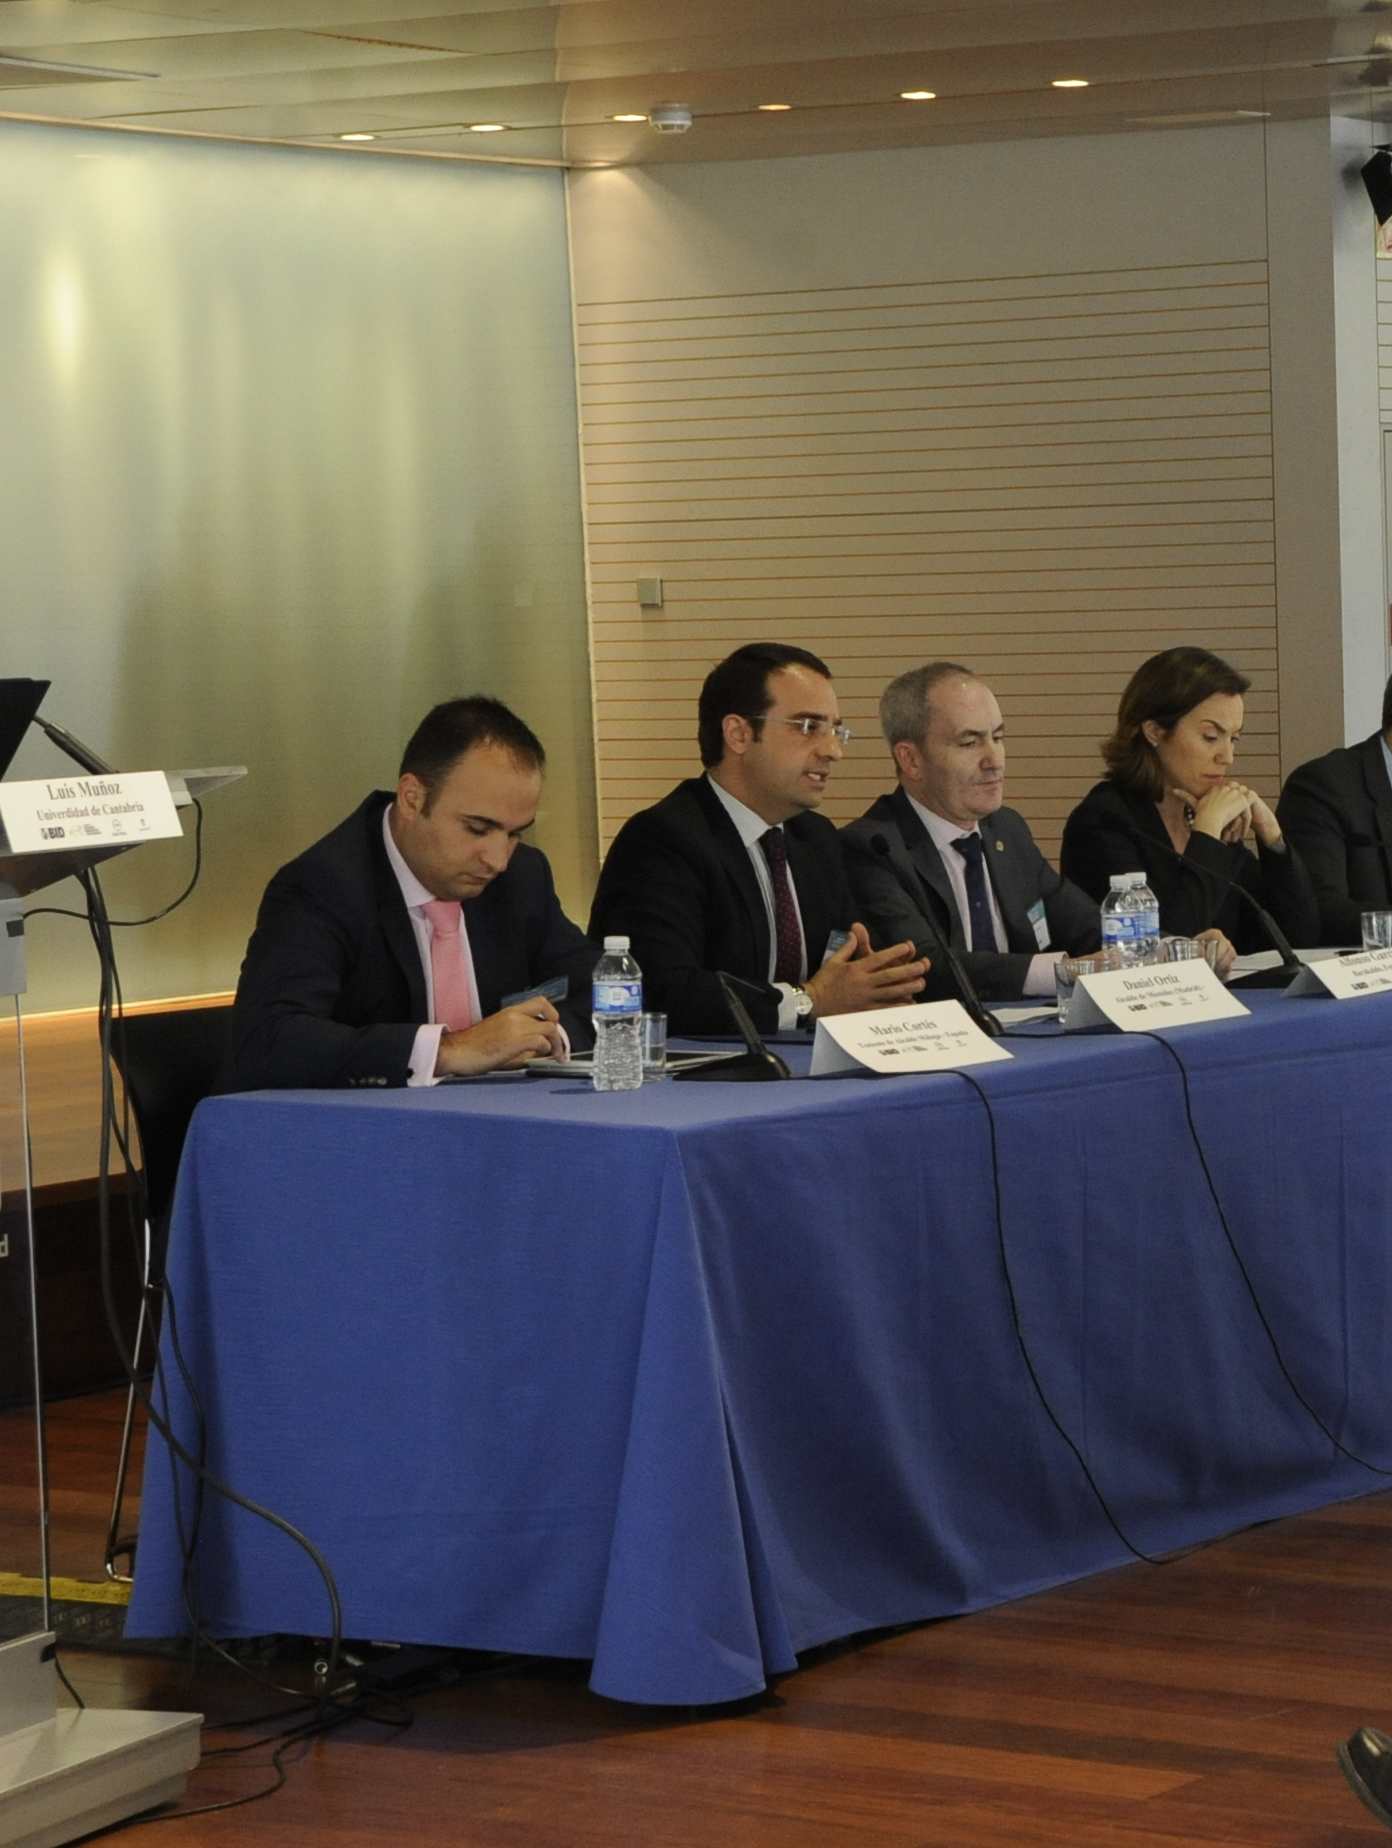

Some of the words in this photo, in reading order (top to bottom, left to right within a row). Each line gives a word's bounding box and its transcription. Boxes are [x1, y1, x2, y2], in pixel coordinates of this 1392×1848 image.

[46, 783, 76, 801] Luis
[77, 779, 122, 799] Muñoz
[91, 804, 101, 816] de
[102, 800, 145, 815] Cantabria
[1122, 977, 1154, 992] Daniel
[868, 1022, 903, 1037] Mario
[902, 1018, 938, 1033] Cortés
